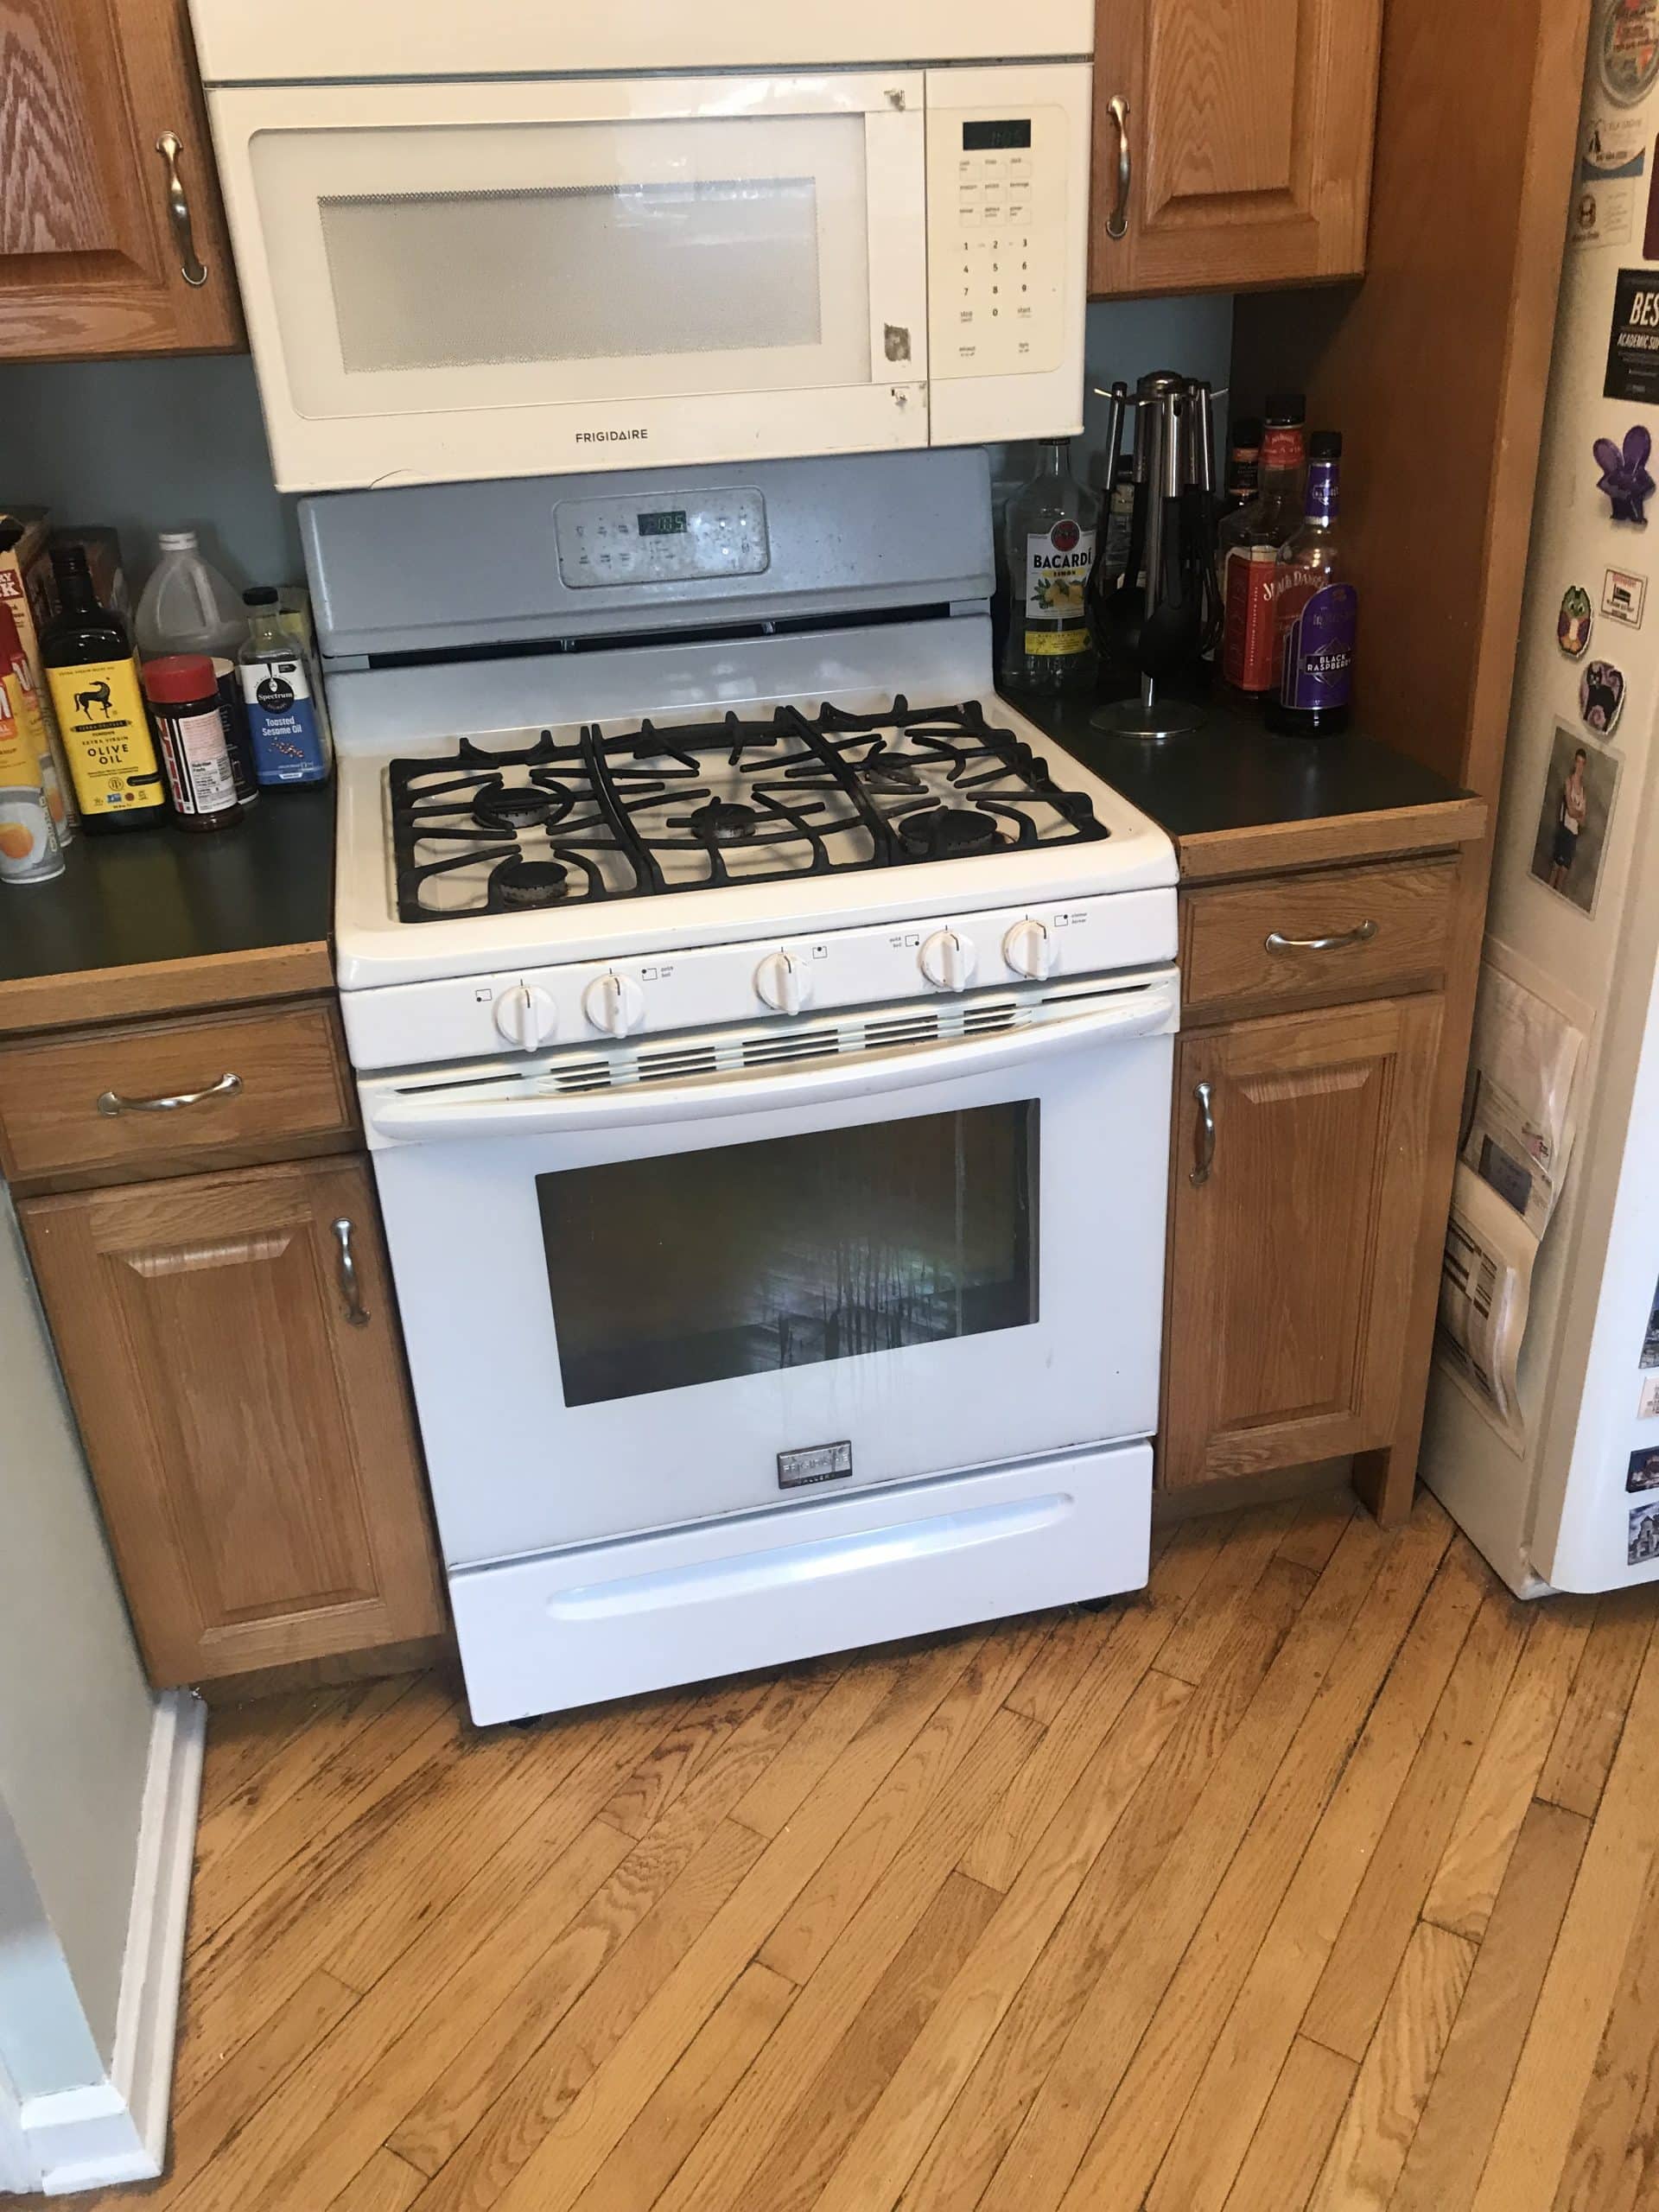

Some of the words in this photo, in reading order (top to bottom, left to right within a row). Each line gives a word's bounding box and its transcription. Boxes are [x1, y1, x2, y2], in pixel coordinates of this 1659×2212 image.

[963, 242, 969, 251] 1
[993, 240, 998, 249] 2
[1022, 238, 1027, 247] 3
[993, 263, 998, 271] 5
[1022, 261, 1027, 270] 6
[963, 287, 969, 296] 7
[992, 308, 998, 316] 0
[575, 429, 648, 442] FRIGIDAIRE
[1033, 547, 1092, 569] BACARDÍ
[1319, 653, 1346, 664] BLACK
[258, 692, 293, 702] Spectrum
[265, 715, 295, 727] Toasted
[262, 727, 291, 736] Sesame
[292, 724, 302, 734] Oil
[87, 743, 129, 757] OLIVE
[99, 754, 123, 765] OIL
